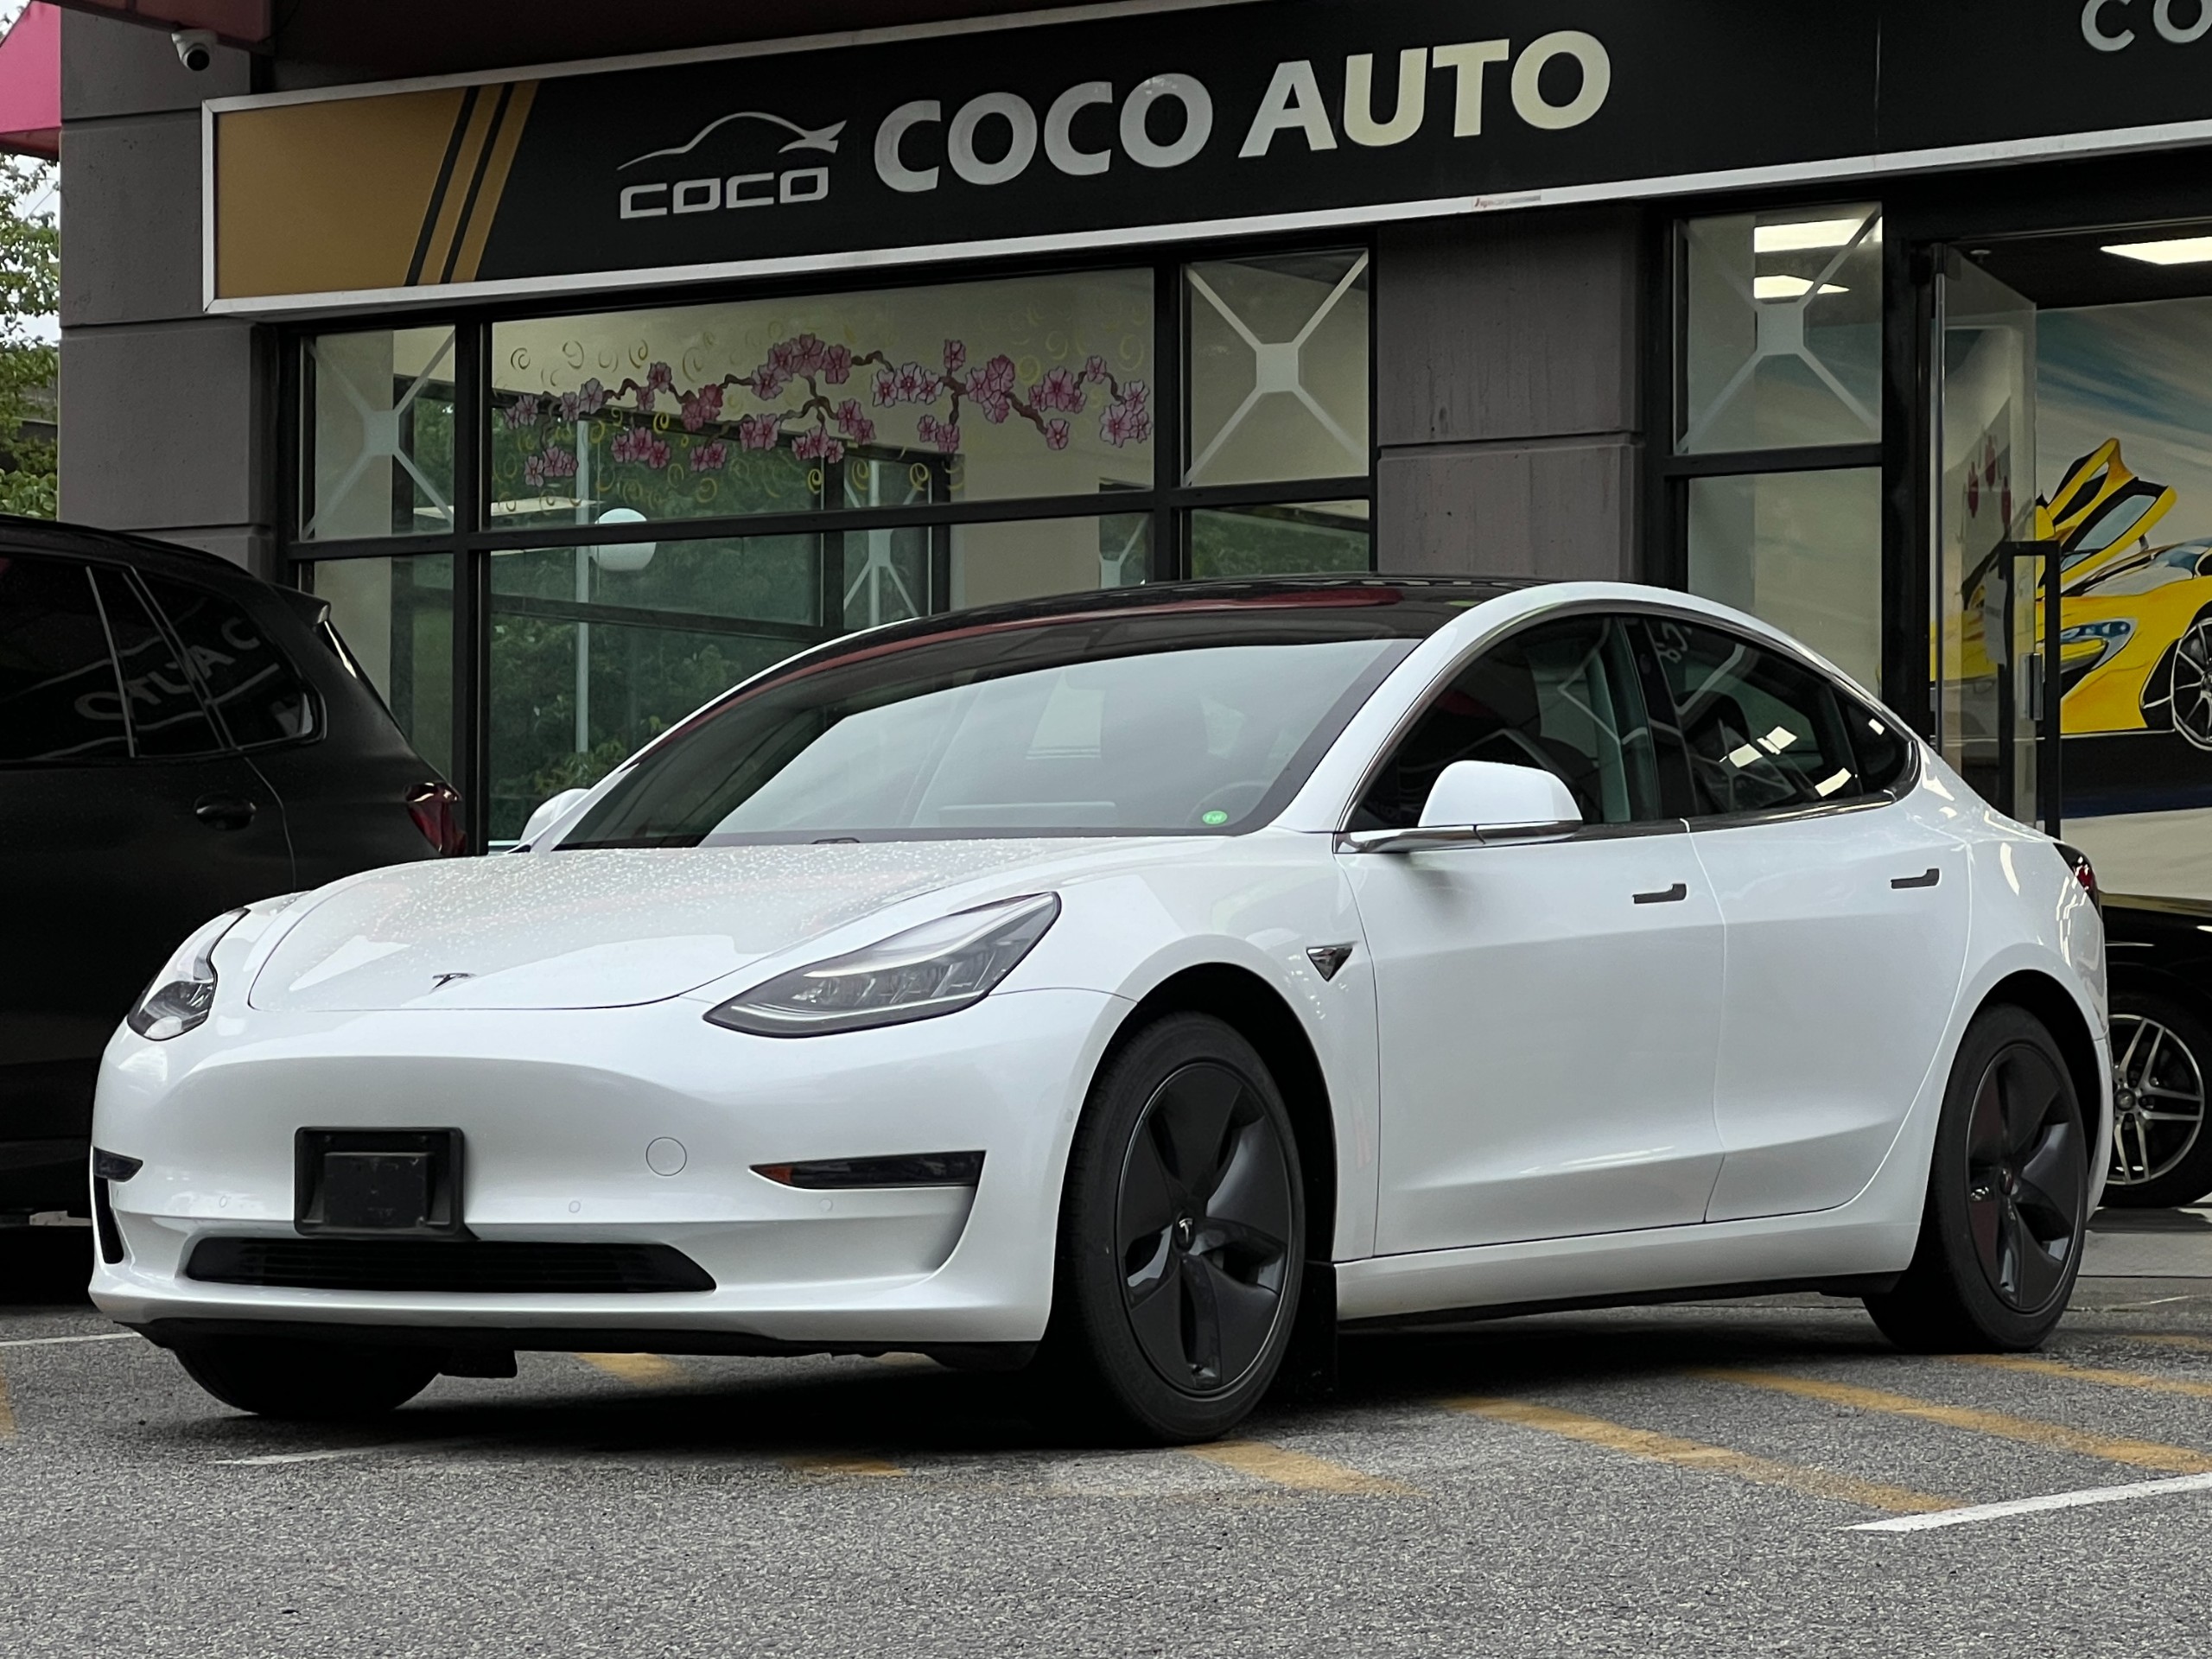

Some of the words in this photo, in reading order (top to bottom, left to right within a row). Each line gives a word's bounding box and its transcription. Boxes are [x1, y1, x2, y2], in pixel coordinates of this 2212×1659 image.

[874, 73, 1214, 193] COCO
[1237, 30, 1611, 158] AUTO
[619, 167, 830, 219] COCO
